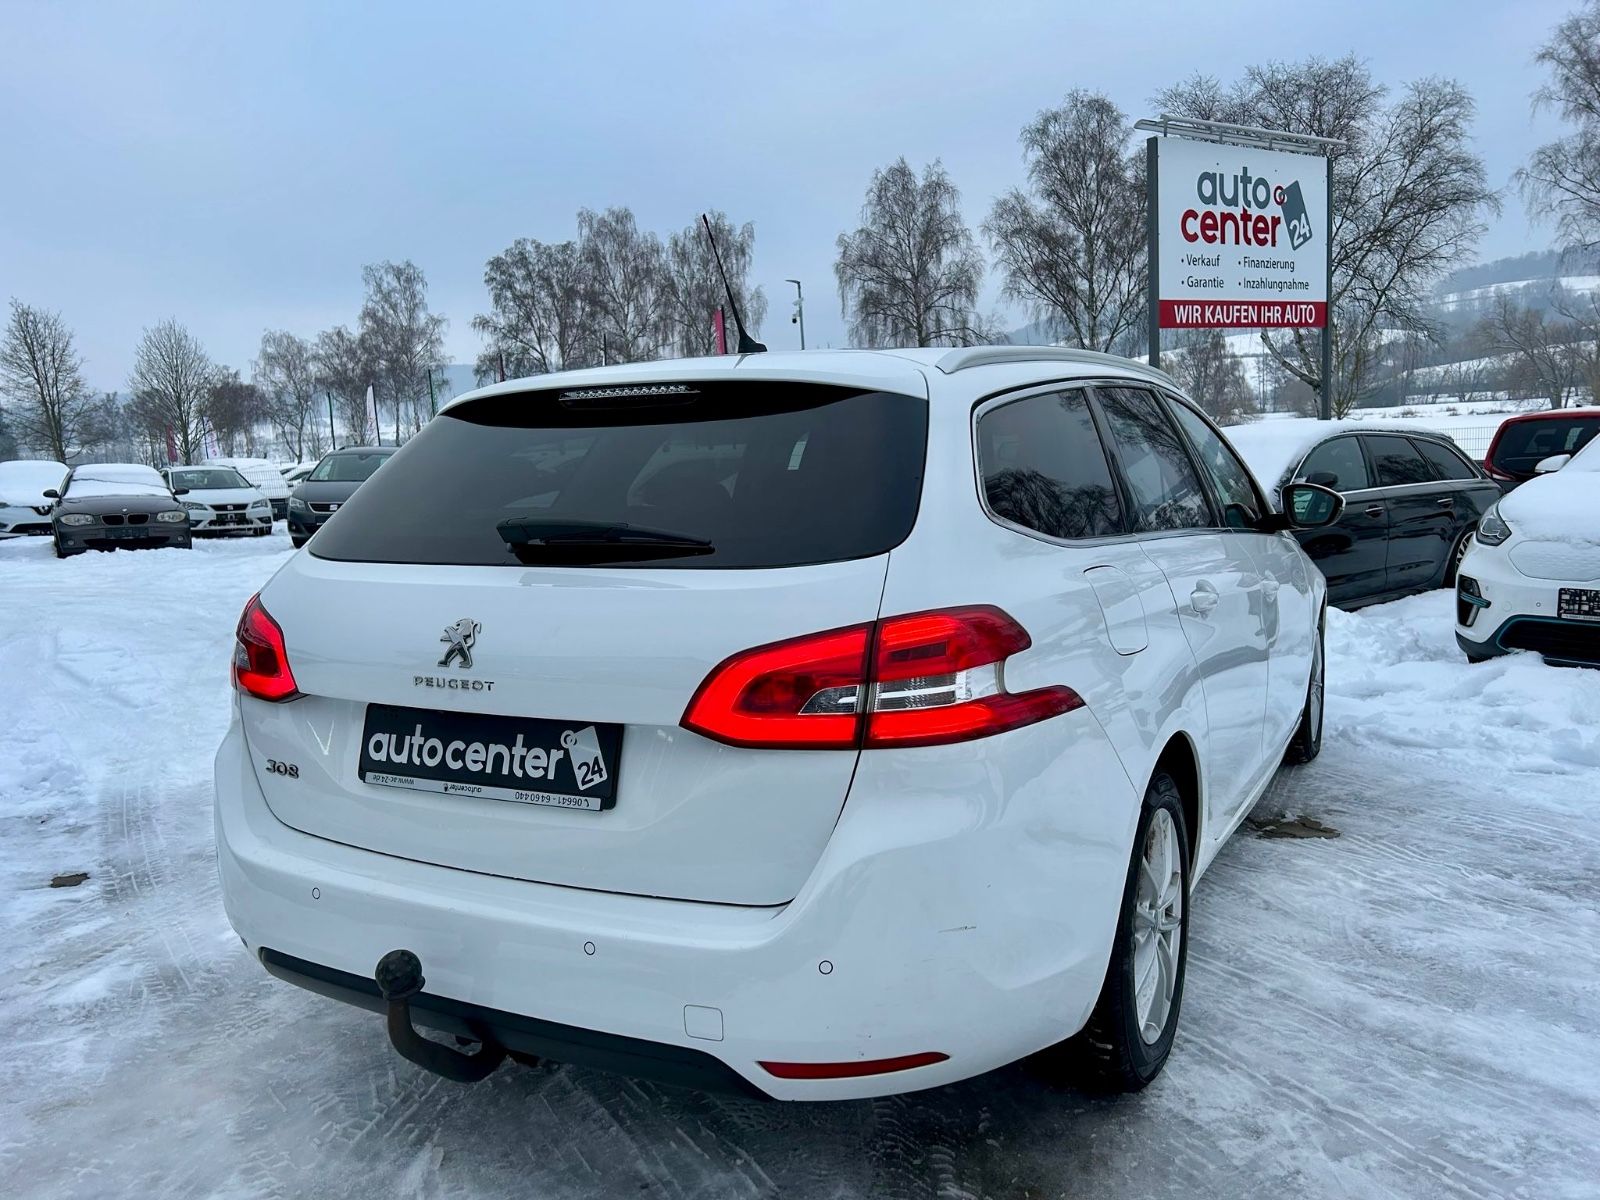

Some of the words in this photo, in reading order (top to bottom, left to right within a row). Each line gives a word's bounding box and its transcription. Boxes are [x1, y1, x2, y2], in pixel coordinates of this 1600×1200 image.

[1197, 167, 1271, 209] auto
[1181, 206, 1281, 247] center
[1289, 213, 1310, 243] 24
[1186, 254, 1220, 267] Verkauf
[1243, 256, 1295, 272] Finanzierung
[1187, 276, 1225, 289] Garantie
[1243, 278, 1310, 292] Inzahlungnahme
[1174, 305, 1201, 324] WIR
[1205, 305, 1258, 324] KAUFEN
[1260, 305, 1282, 324] IHR
[1284, 304, 1316, 324] AUTO
[413, 675, 495, 692] PEUGEOT
[368, 724, 564, 780] autocenter
[265, 759, 300, 779] 308
[577, 755, 604, 787] 24
